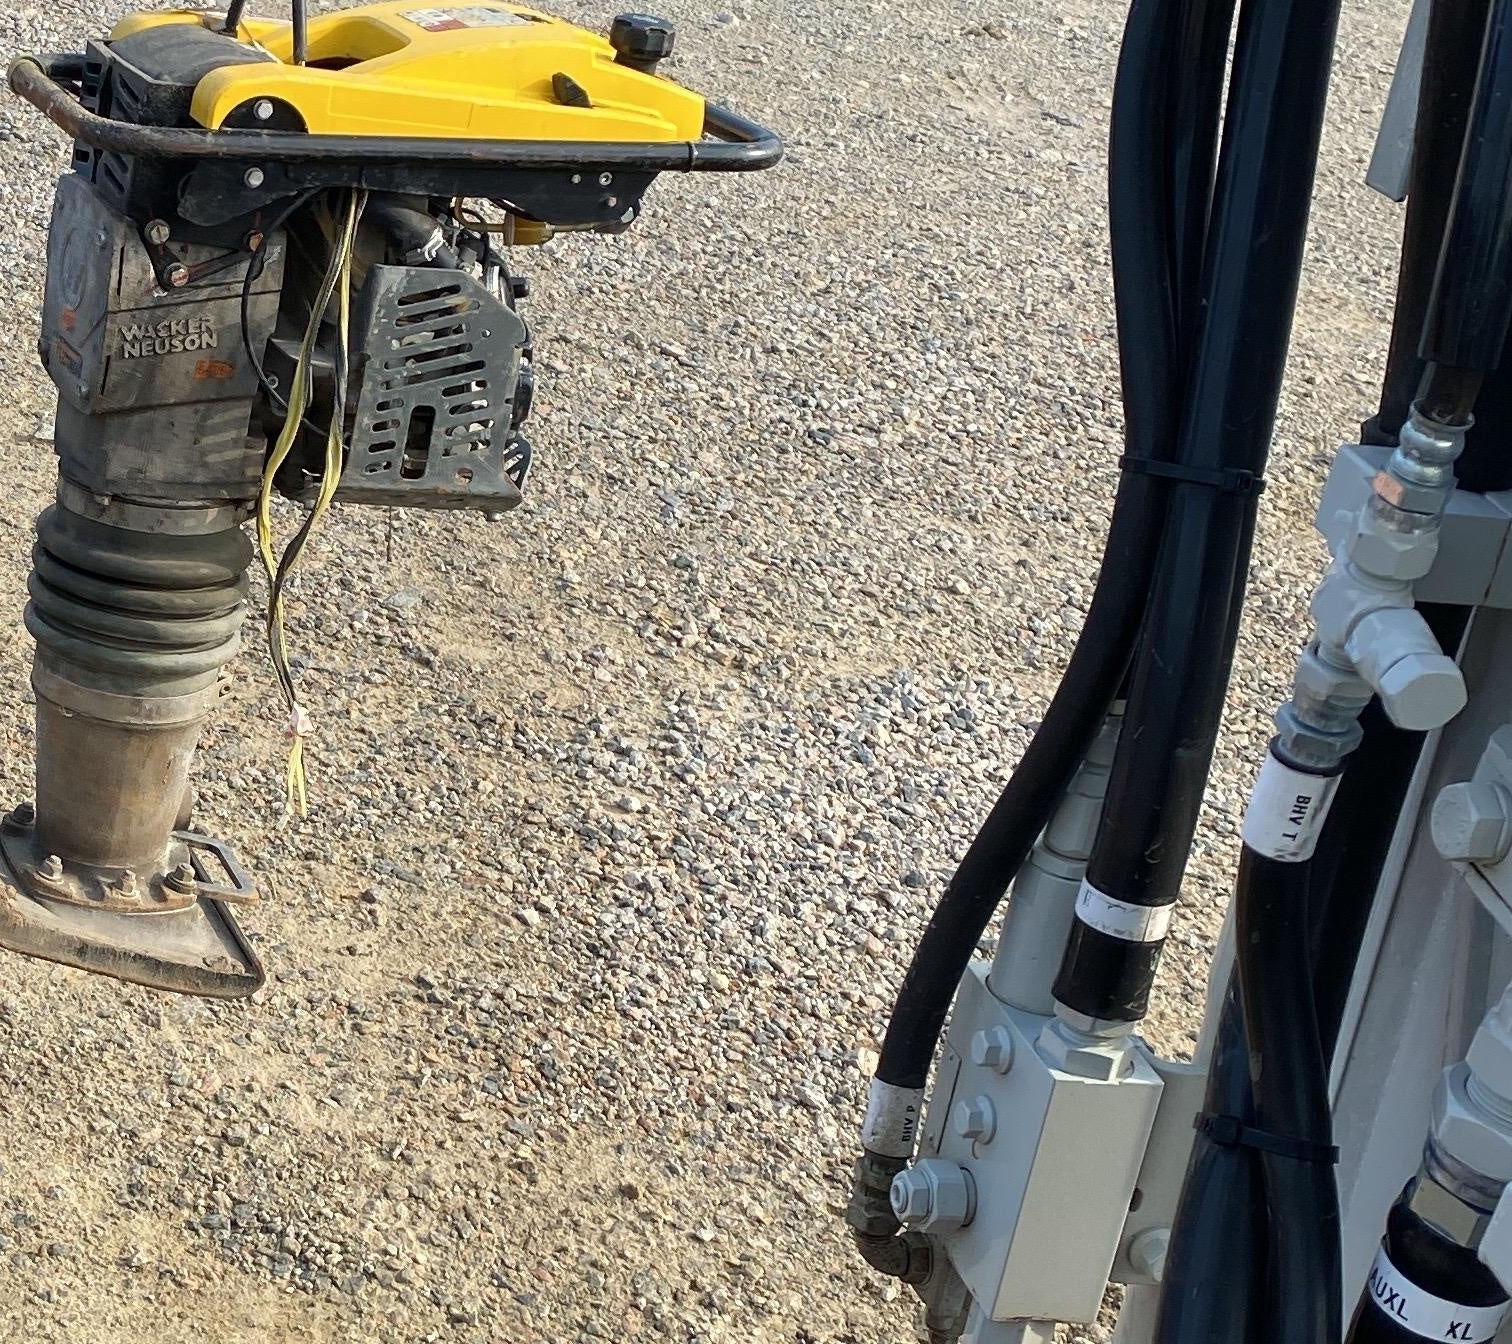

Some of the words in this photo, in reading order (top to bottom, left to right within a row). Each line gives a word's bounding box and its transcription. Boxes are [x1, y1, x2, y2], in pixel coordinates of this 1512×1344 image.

[121, 317, 216, 342] WACKER
[123, 331, 218, 358] NEUSON
[1287, 794, 1313, 827] BHV
[1282, 832, 1298, 841] T
[1369, 1266, 1409, 1322] AUXL
[1444, 1320, 1473, 1341] XL
